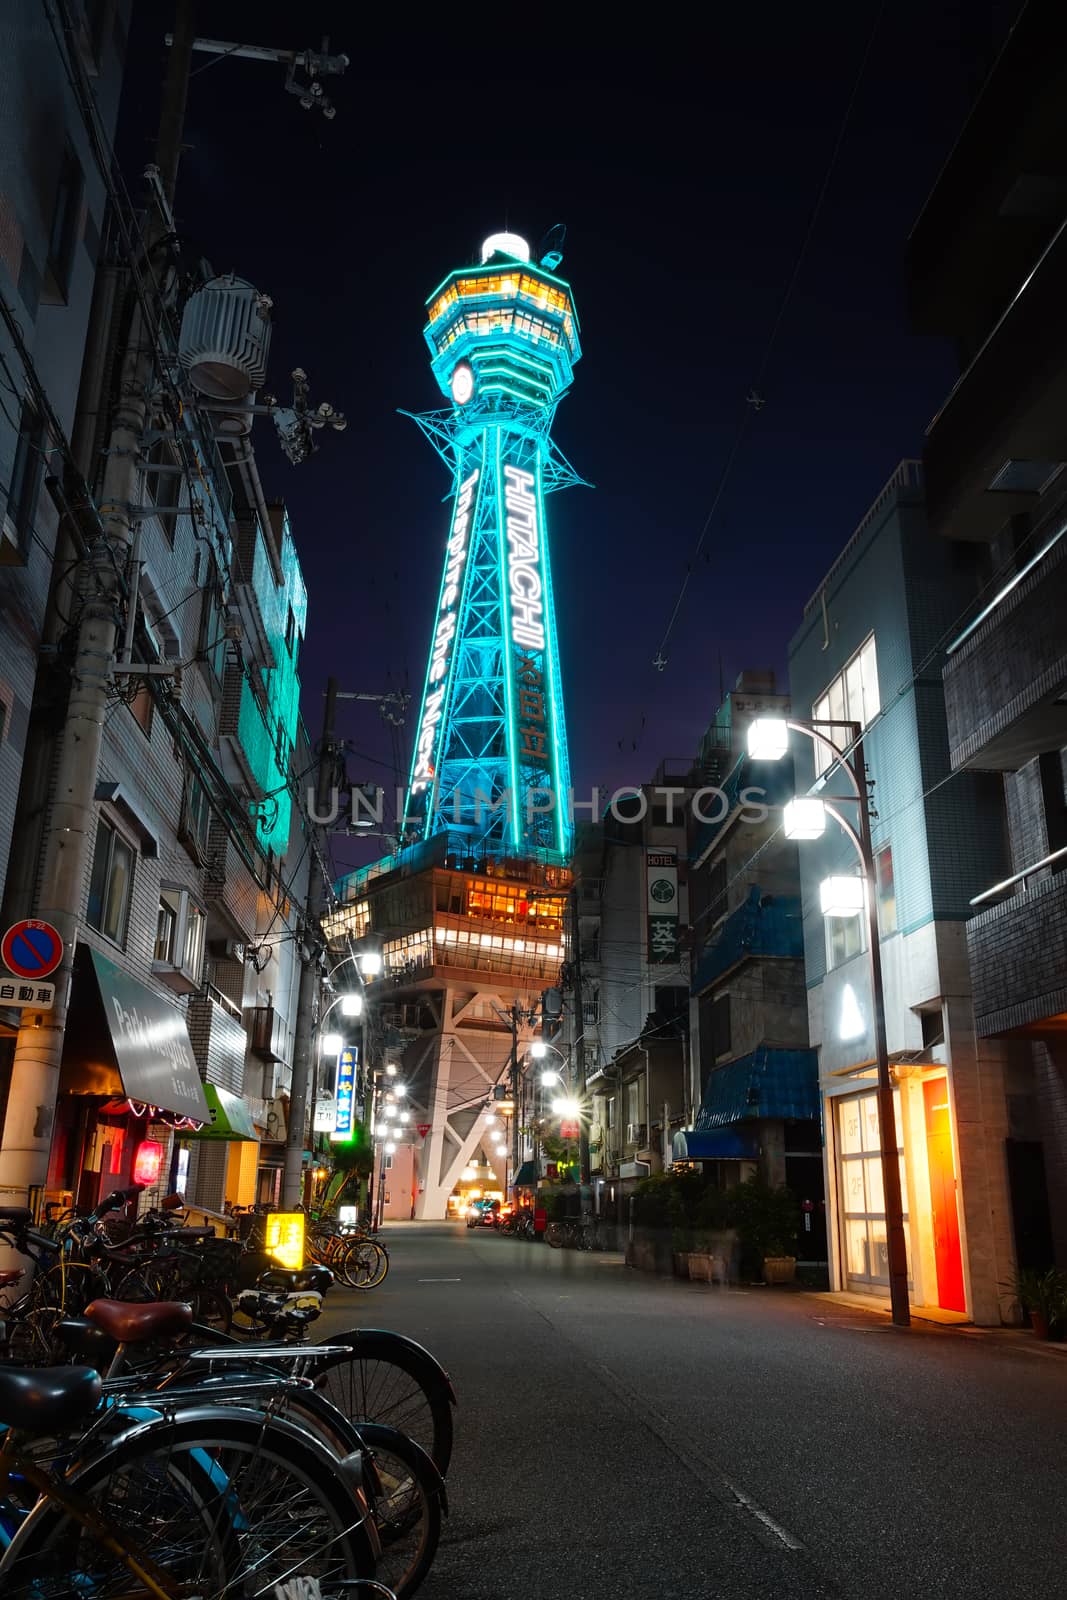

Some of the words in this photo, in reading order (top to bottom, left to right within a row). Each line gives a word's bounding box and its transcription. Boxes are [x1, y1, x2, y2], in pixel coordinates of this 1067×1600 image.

[440, 468, 480, 609] Inspire
[504, 465, 545, 650] HITACHI
[429, 612, 456, 684] the
[411, 687, 447, 795] Next
[647, 855, 673, 865] HOTEL
[0, 983, 53, 1003] 自動車
[111, 995, 149, 1049] Park
